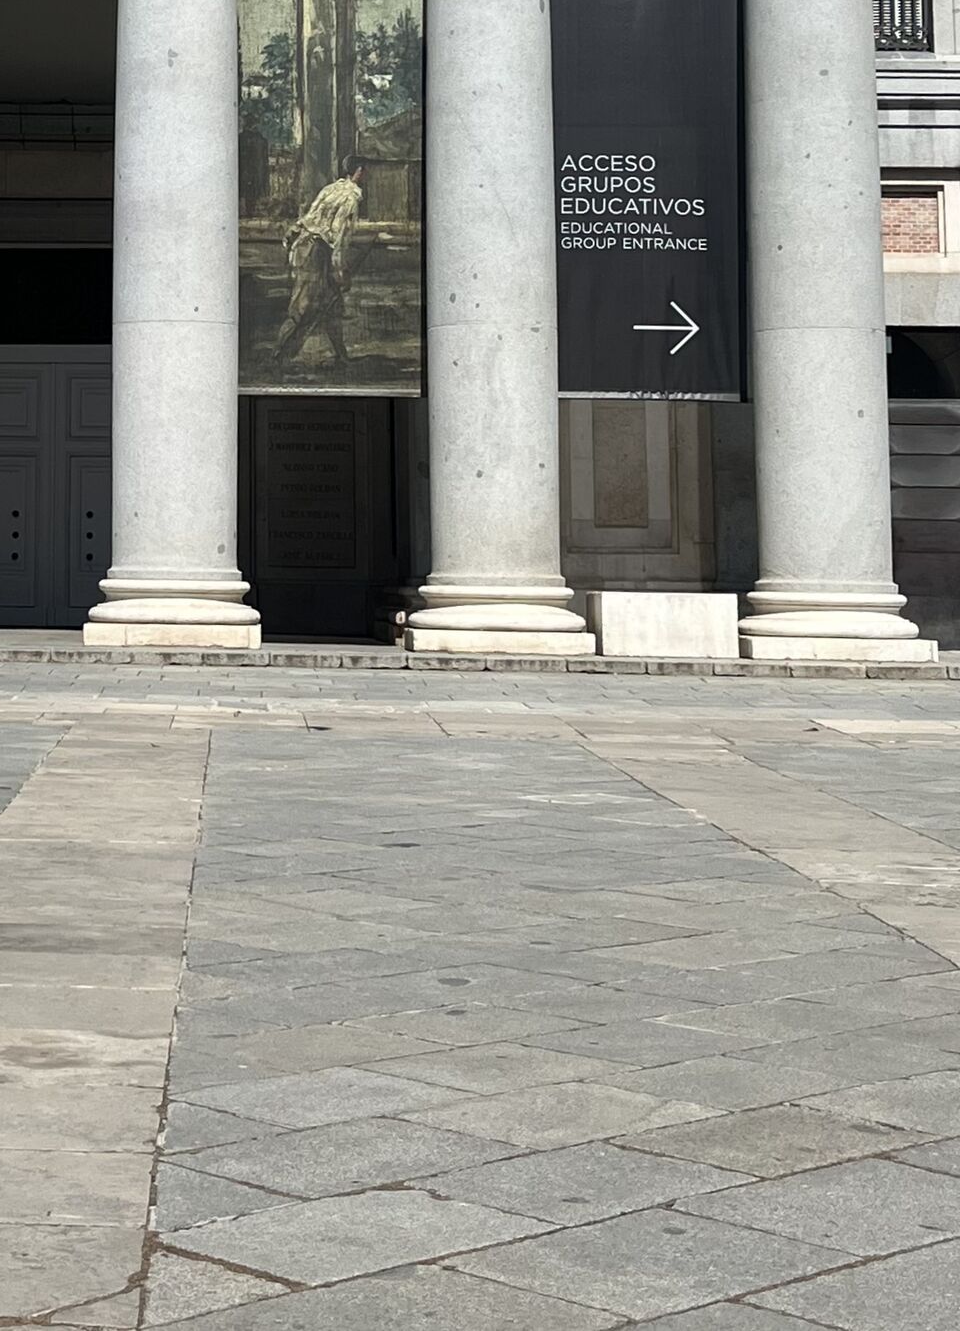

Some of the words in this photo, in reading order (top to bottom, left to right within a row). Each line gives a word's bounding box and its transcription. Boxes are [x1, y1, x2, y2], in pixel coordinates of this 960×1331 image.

[561, 155, 655, 171] ACCESO
[561, 176, 655, 193] GRUPOS
[561, 198, 704, 215] EDUCATIVOS
[561, 222, 672, 234] EDUCATIONAL
[561, 237, 616, 249] GROUP
[623, 238, 707, 250] ENTRANCE
